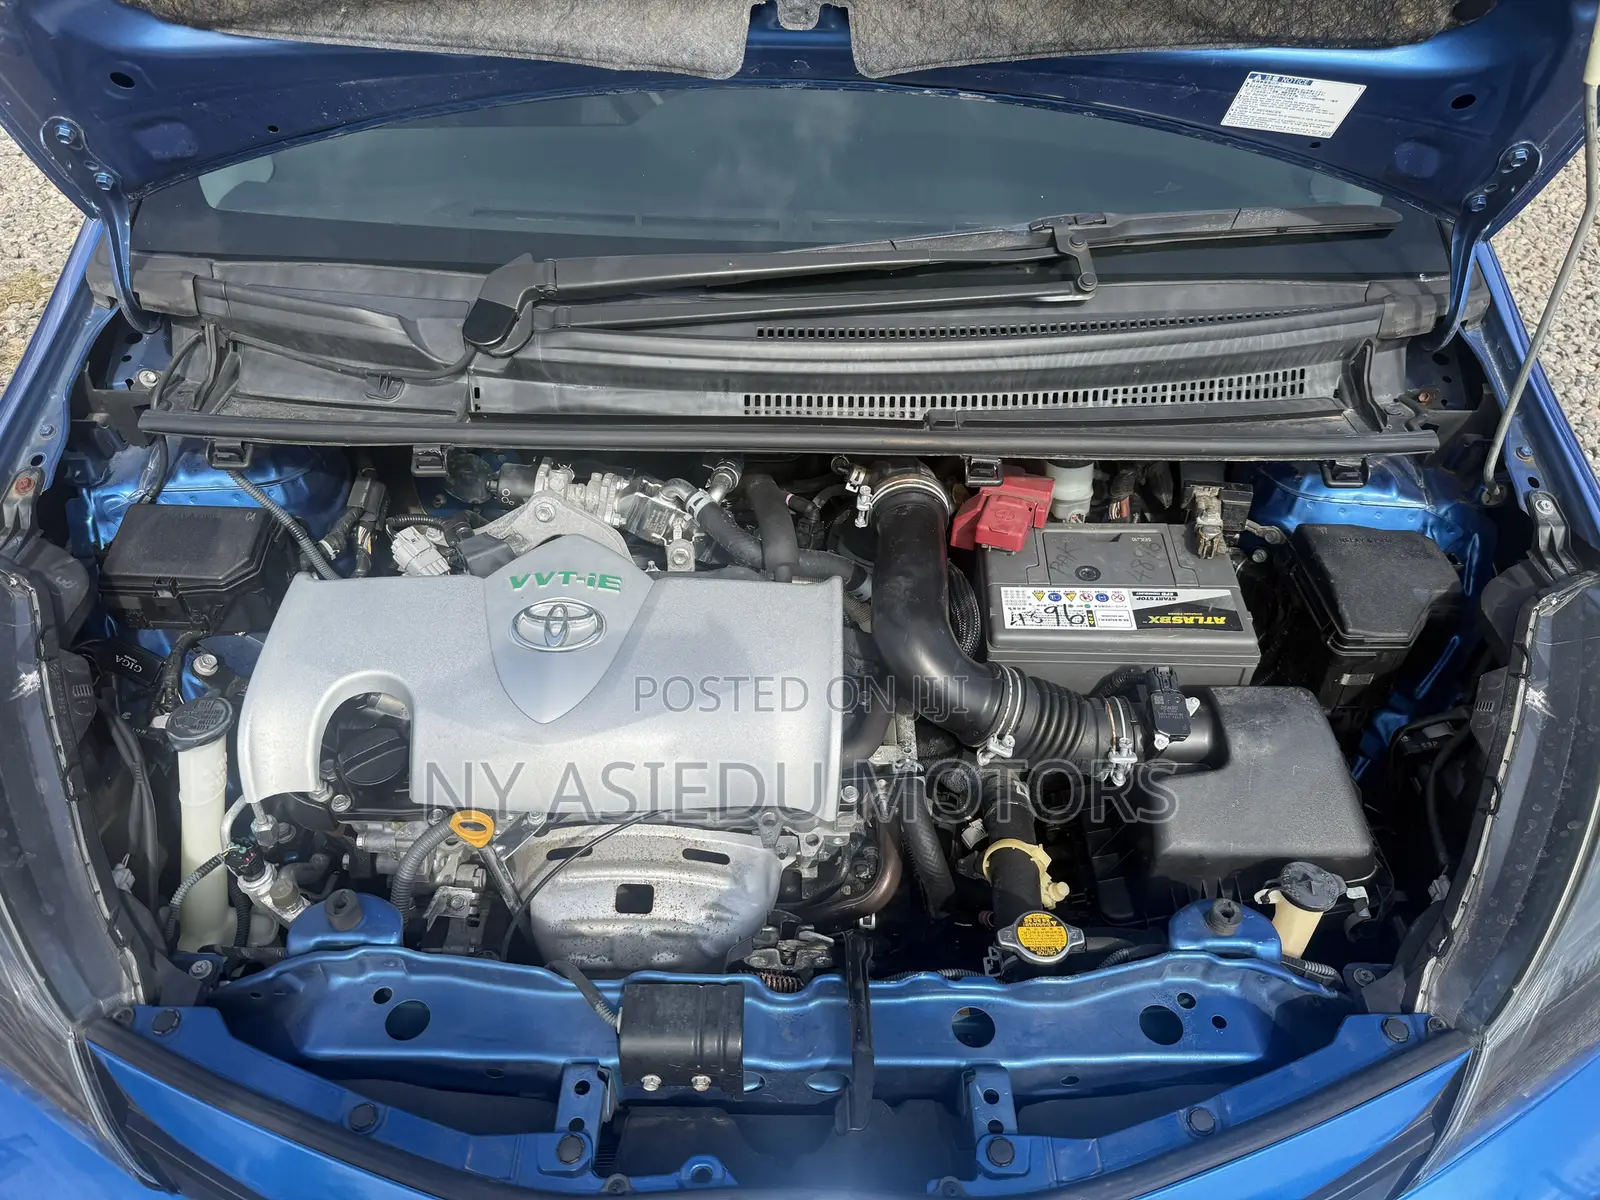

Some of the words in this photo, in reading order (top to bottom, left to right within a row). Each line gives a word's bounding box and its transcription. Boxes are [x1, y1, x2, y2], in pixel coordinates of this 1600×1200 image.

[1281, 76, 1309, 86] NOTICE
[508, 570, 622, 593] VVT-iE
[1147, 615, 1227, 625] ATLASBX
[115, 654, 143, 673] GIGA
